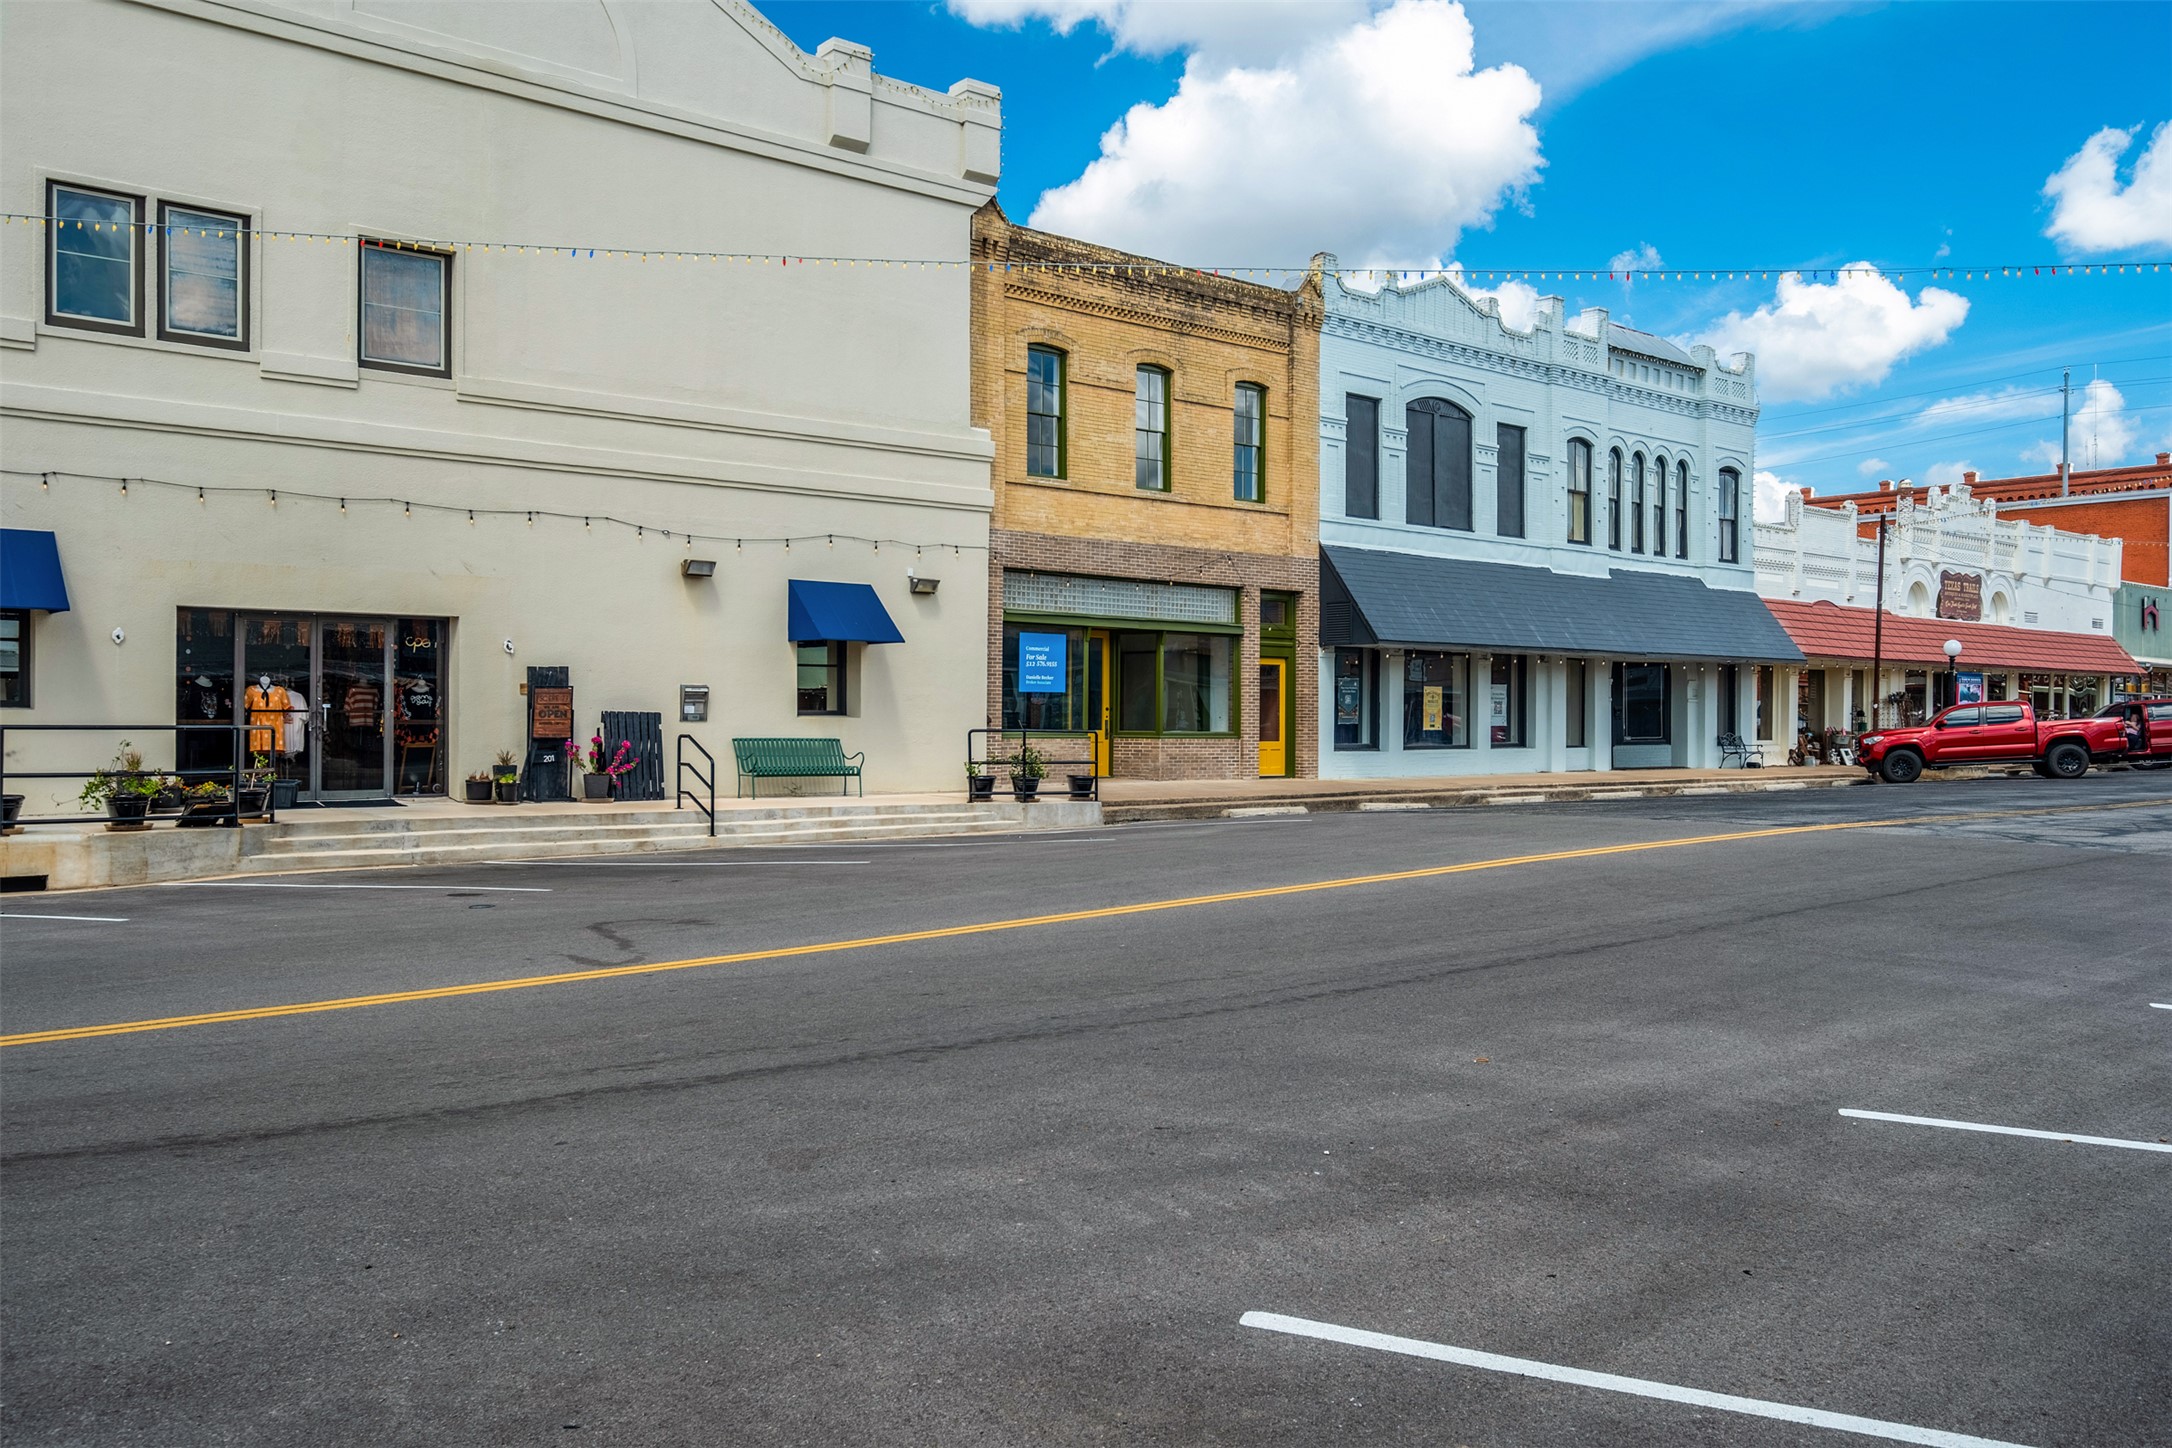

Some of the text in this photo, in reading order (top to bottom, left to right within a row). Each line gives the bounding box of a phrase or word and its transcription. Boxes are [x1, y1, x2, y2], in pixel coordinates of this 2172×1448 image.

[1944, 580, 1979, 594] TEXAS TRAILS
[538, 709, 568, 719] OPEN
[543, 755, 555, 763] 201
